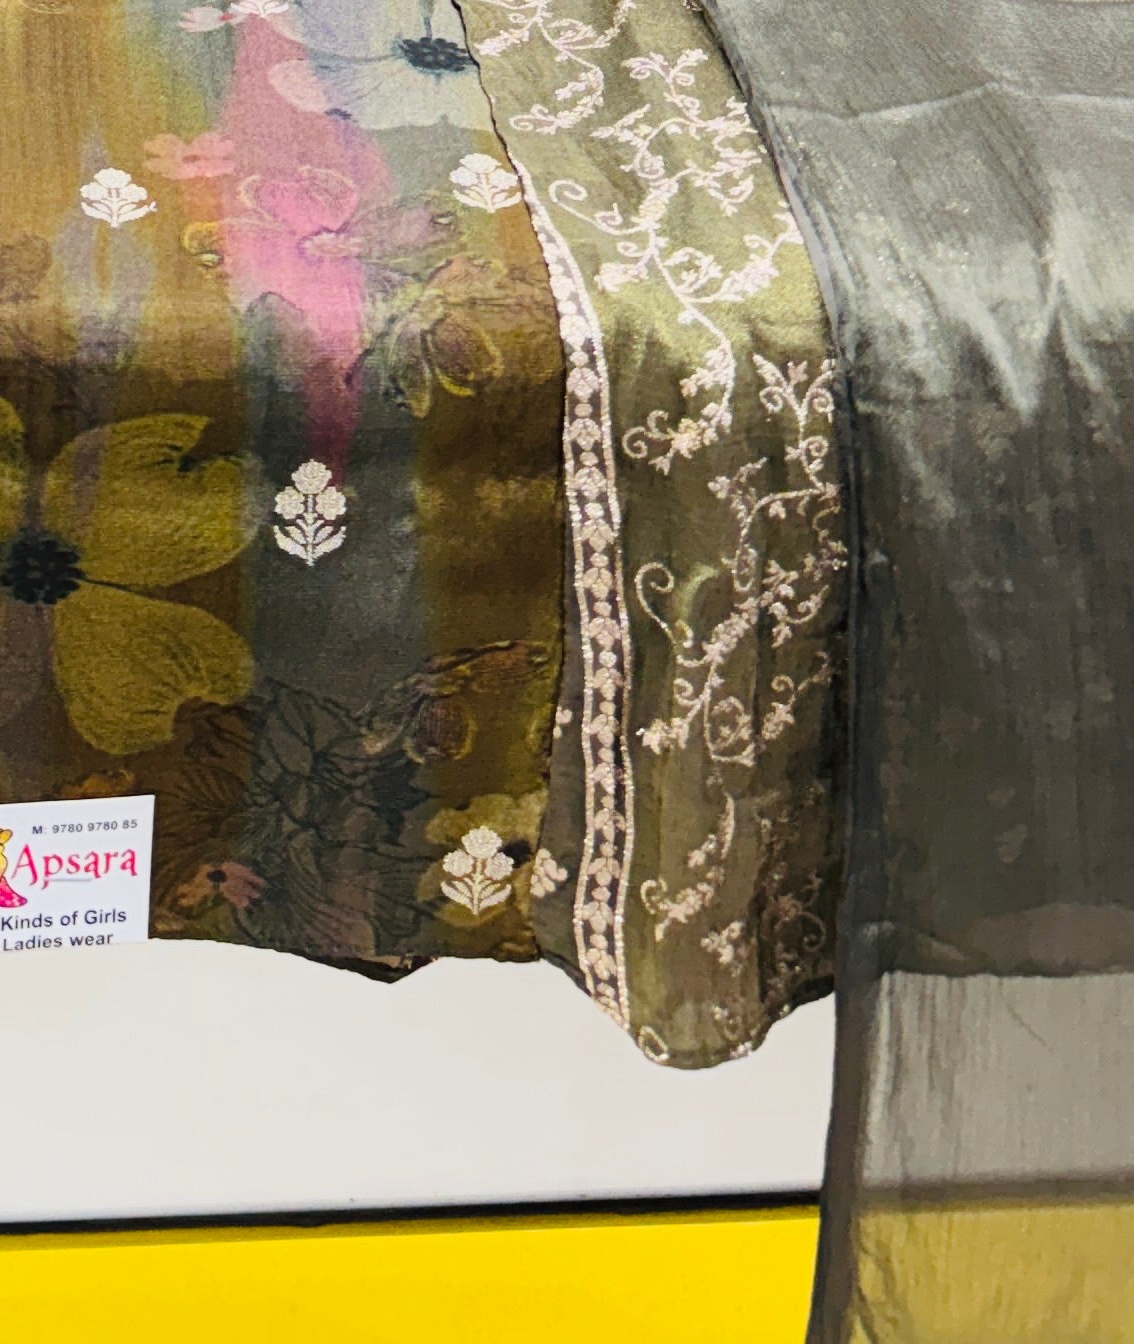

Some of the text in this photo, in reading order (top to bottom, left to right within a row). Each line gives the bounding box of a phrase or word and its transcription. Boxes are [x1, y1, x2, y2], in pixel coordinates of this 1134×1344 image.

[32, 825, 47, 835] M:
[52, 823, 83, 834] 9780
[87, 821, 118, 832] 9780
[11, 843, 138, 890] Apsara
[1, 914, 53, 931] Kinds
[60, 911, 78, 926] of
[84, 909, 127, 924] Girls
[3, 936, 62, 951] Ladies
[69, 933, 114, 946] wear
